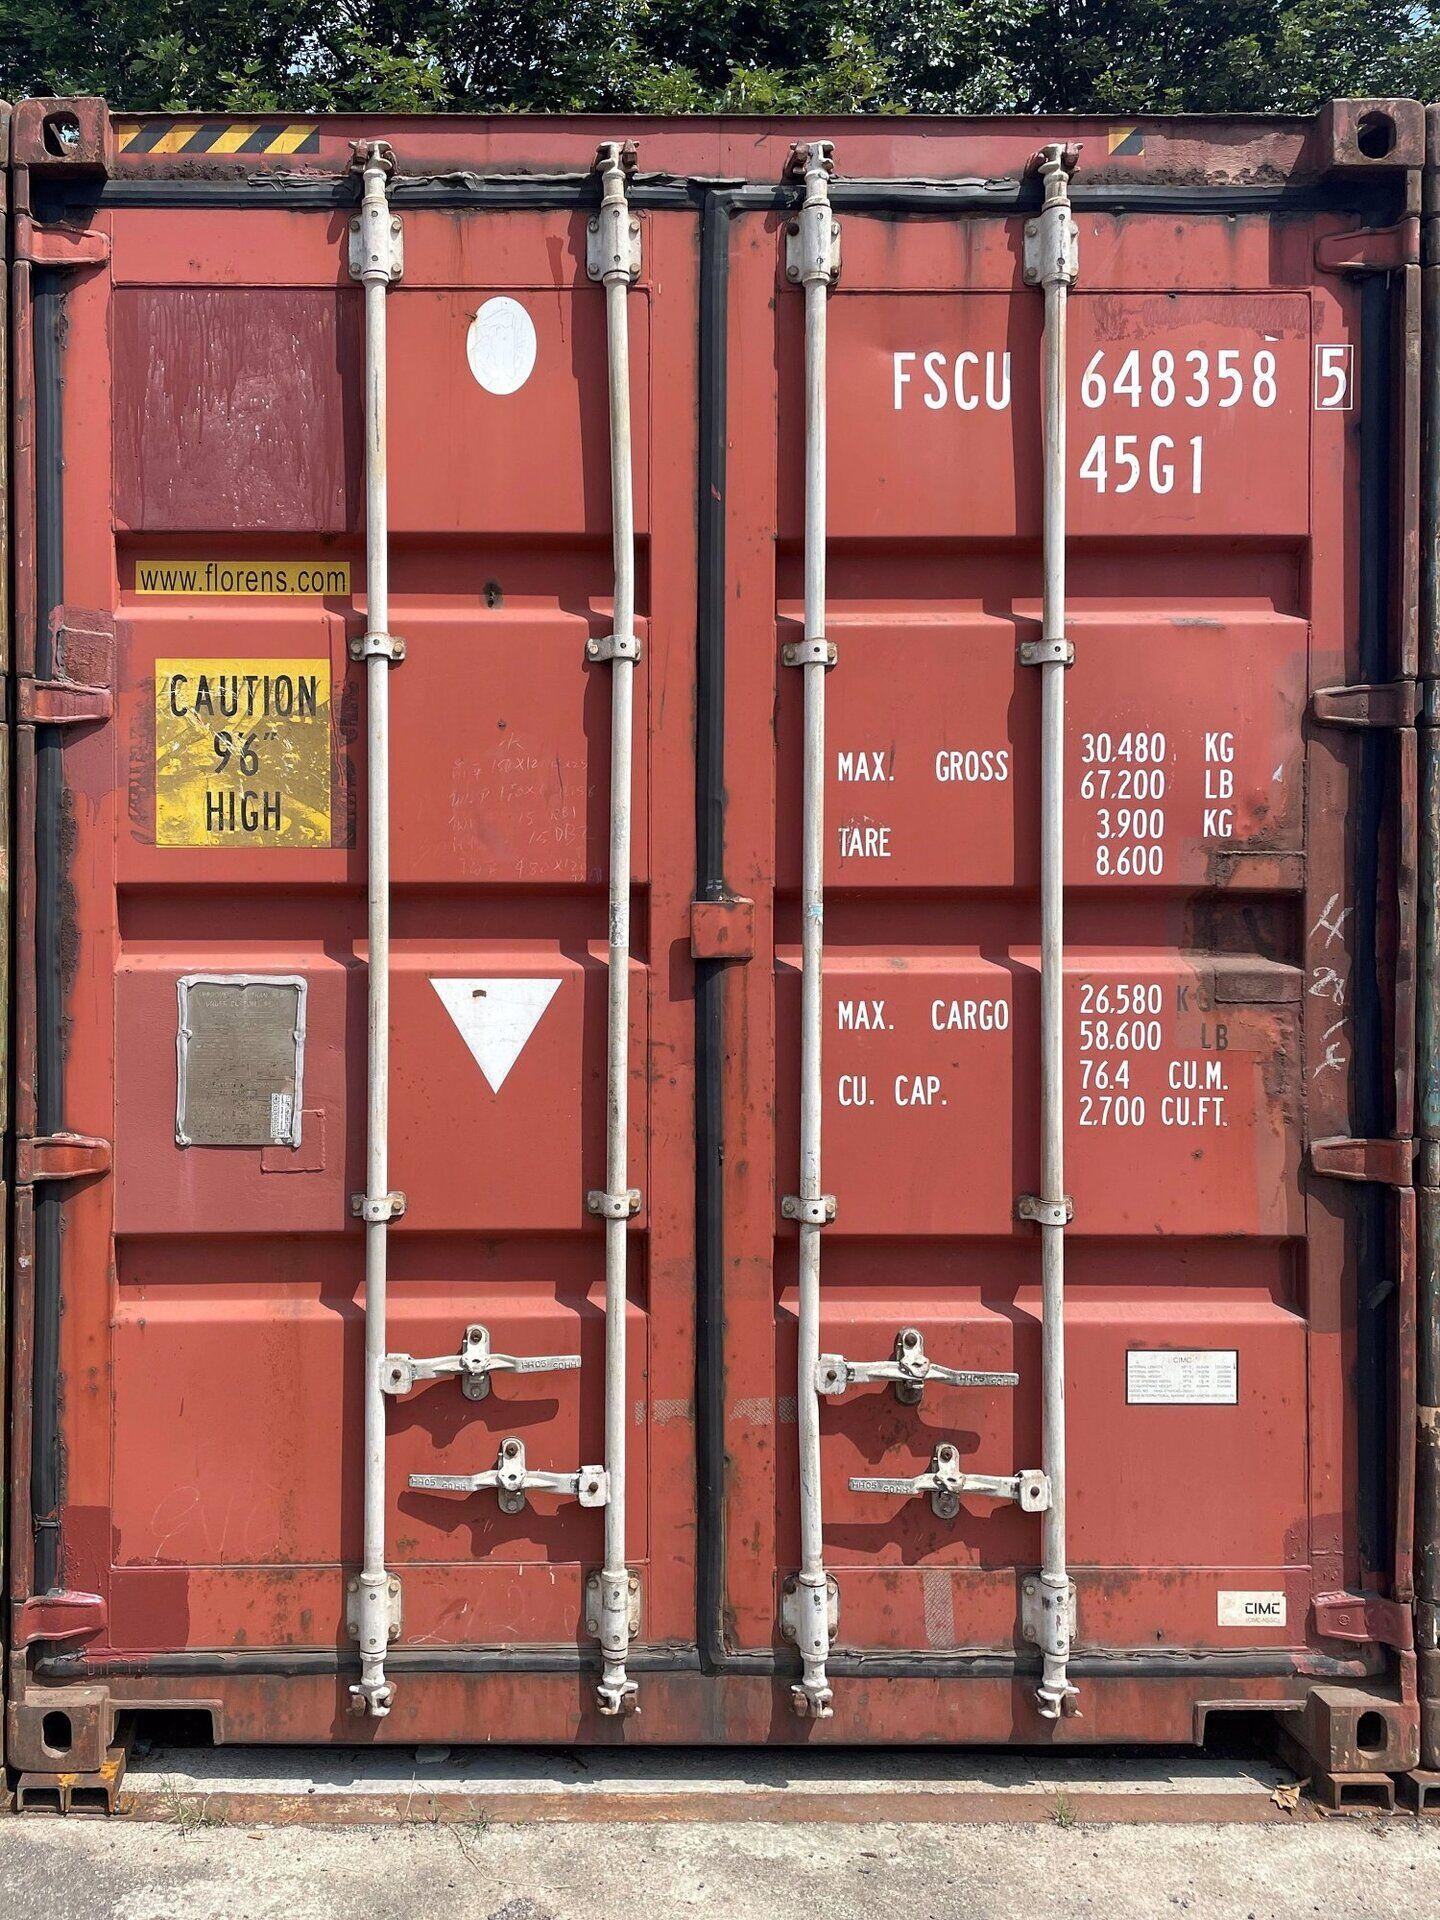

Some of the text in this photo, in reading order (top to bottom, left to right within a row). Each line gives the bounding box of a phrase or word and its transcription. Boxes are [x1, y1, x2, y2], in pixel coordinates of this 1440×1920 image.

[893, 348, 1346, 410] FSCU 648358 5
[1079, 435, 1203, 494] 45G1
[140, 563, 346, 592] www.florens.com
[170, 674, 317, 717] CAUTION
[1081, 732, 1234, 763] 30,480 KG
[838, 750, 1009, 782] MAX. GROSS
[1080, 769, 1234, 800] 67,200 LB
[206, 791, 281, 832] HIGH
[1096, 808, 1233, 839] 3,900 KG
[838, 827, 892, 857] TARE
[1096, 845, 1163, 876] 8,600
[1080, 984, 1162, 1014] 26,580
[838, 1000, 1009, 1031] MAX. CARGO
[1080, 1021, 1229, 1051] 58,600 LB
[838, 1075, 949, 1106] CU. CAP.
[1080, 1060, 1229, 1090] 76.4 CU.M.
[1079, 1096, 1228, 1126] 2,700 CU.FT.
[1245, 1603, 1280, 1614] CIMC
